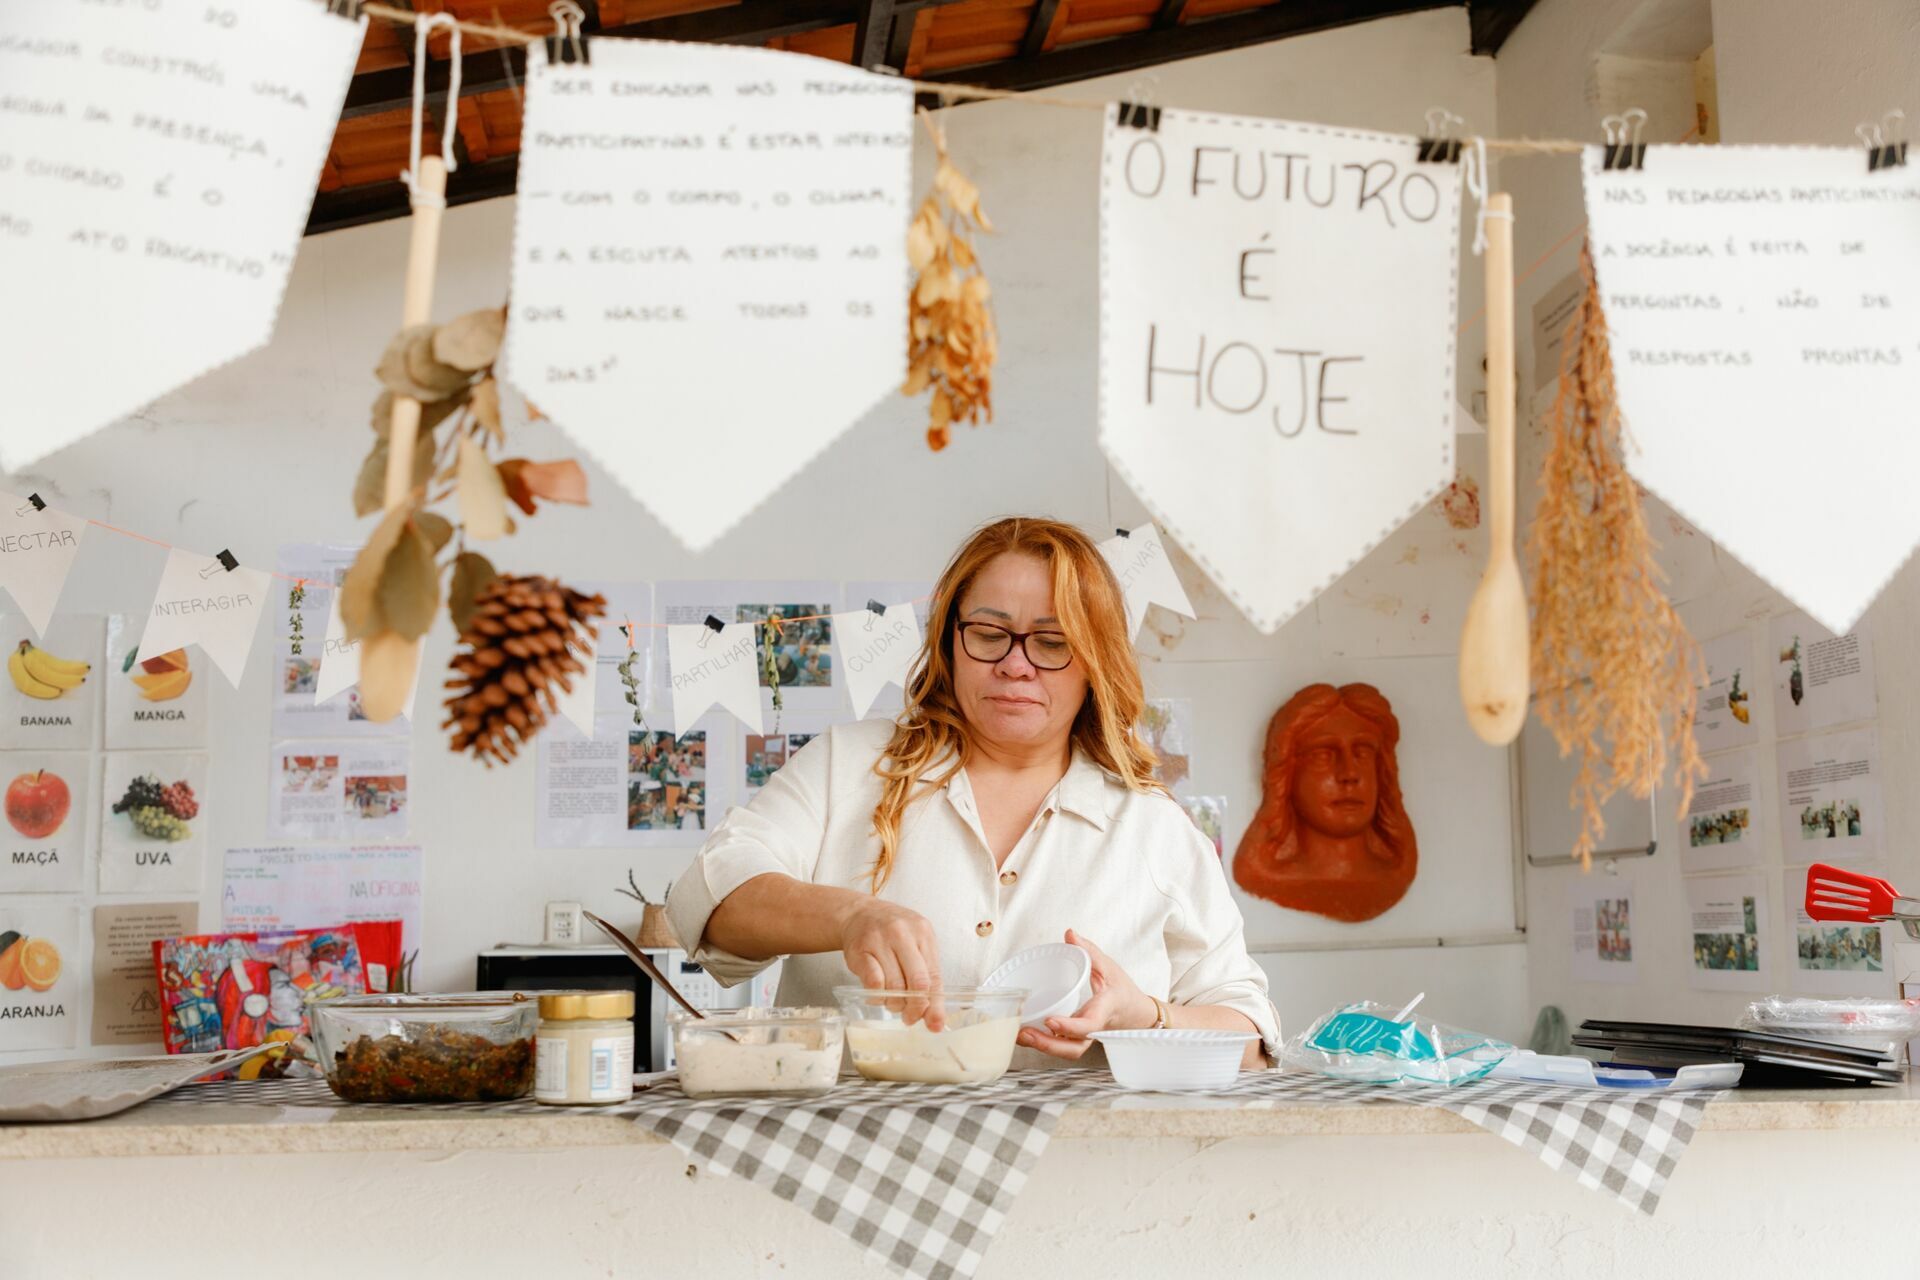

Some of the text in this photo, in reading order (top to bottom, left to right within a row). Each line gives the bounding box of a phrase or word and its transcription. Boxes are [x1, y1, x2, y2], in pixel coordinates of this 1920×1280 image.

[609, 79, 714, 99] EDUCADOR
[534, 130, 706, 151] PARTICIPATIVAS
[747, 131, 824, 152] ESTAR
[1125, 136, 1441, 229] O FUTURO
[200, 186, 226, 209] O
[561, 187, 614, 207] COM
[632, 187, 652, 206] O
[772, 189, 792, 207] O
[1604, 186, 1647, 205] NAS
[528, 243, 881, 266] E A ESCUTA ATENTOS AO
[1601, 242, 1619, 258] A
[1748, 238, 1810, 257] FEITA
[1239, 231, 1277, 301] É
[521, 303, 568, 324] QUE
[603, 303, 689, 323] NASCE
[1627, 347, 1754, 367] RESPOSTAS
[1146, 322, 1365, 438] HOJE
[154, 593, 253, 617] INTERAGIR
[847, 620, 912, 674] CUIDAR
[672, 636, 758, 692] PARTILHAR
[20, 715, 72, 727] BANANA
[133, 710, 186, 722] MANGA
[12, 849, 59, 866] MAÇÃ
[135, 852, 172, 866] UVA
[0, 1004, 65, 1019] ARANJA
